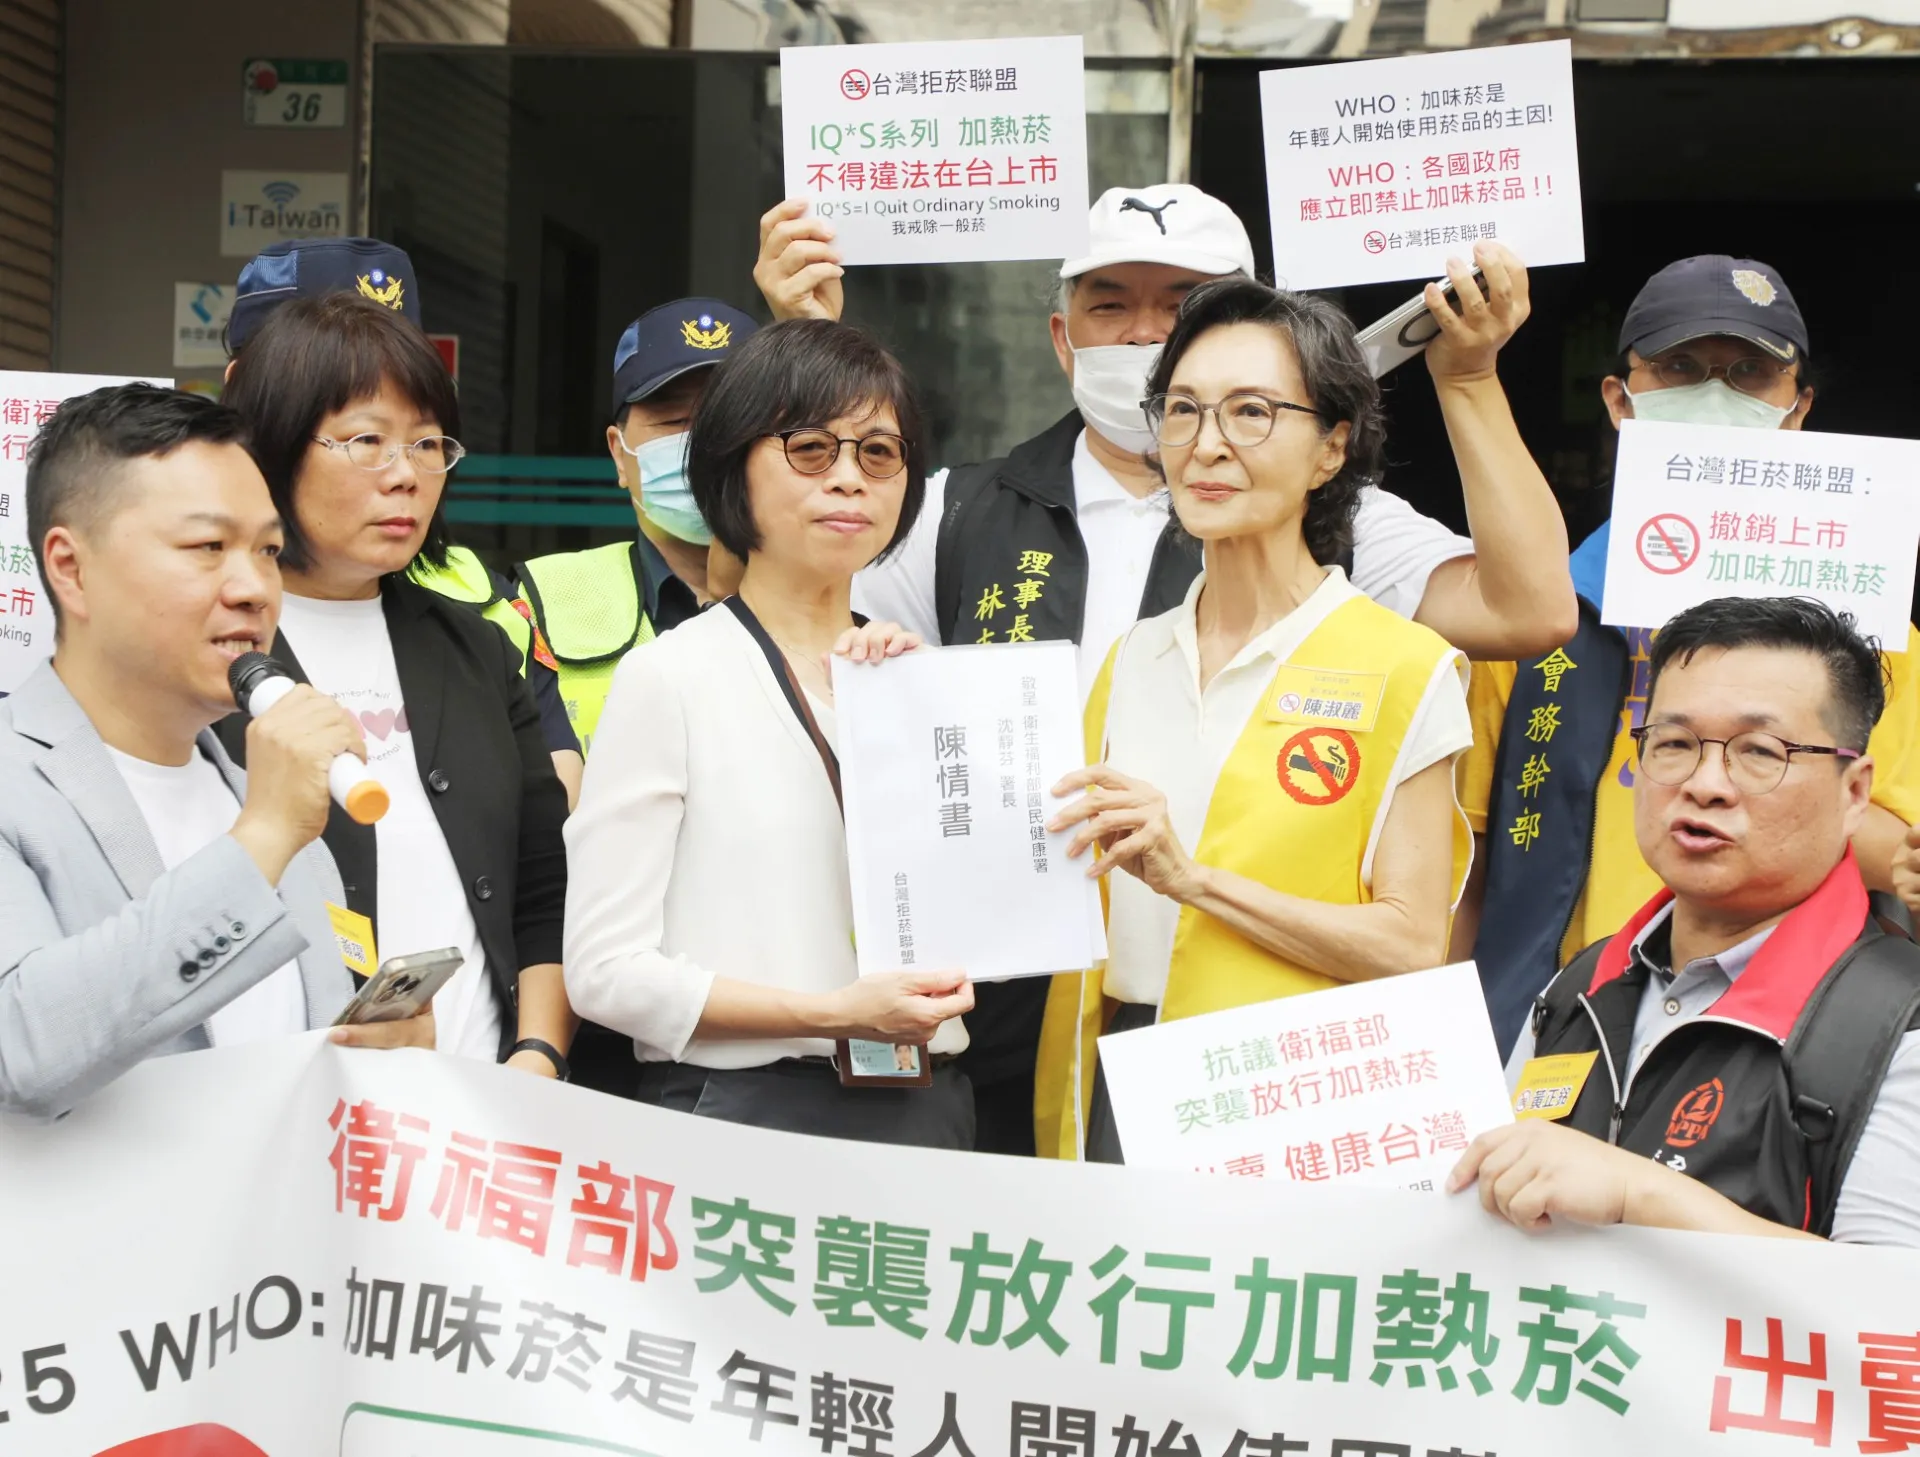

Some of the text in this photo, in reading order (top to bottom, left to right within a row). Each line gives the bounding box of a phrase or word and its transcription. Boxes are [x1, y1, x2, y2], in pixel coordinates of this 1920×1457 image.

[872, 67, 1018, 96] 台灣拒菸聯盟
[282, 93, 322, 122] 36
[1289, 105, 1553, 149] 年輕人開始使用菸品的主因!
[958, 114, 1051, 147] 加熱菸
[807, 155, 1058, 193] 不得違法在台上市
[874, 200, 908, 217] Quit
[913, 196, 985, 214] Ordinary
[988, 194, 1060, 212] Smoking
[892, 217, 986, 236] 我戒除一般菸
[1387, 221, 1497, 250] 台灣拒菸聯盟
[1666, 454, 1871, 495] 台灣拒菸聯盟：
[1709, 511, 1849, 550] 撤銷上市
[1706, 550, 1887, 596] 加味加熱菸
[1005, 550, 1053, 644] 理事長
[1302, 698, 1362, 720] 陳淑麗
[1508, 647, 1578, 852] 會務幹部
[934, 724, 973, 838] 陳情書
[1000, 775, 1018, 808] 署長
[1023, 714, 1048, 874] 衛生福利部國民健康署
[894, 872, 915, 965] 台灣拒菸聯盟
[1203, 1013, 1391, 1081] 抗議衛福部
[1174, 1049, 1438, 1135] 突襲放行加熱菸
[1285, 1109, 1471, 1182] 健康台灣
[327, 1097, 1648, 1417] 衛福部突襲放行加熱菸
[0, 1343, 77, 1423] 5
